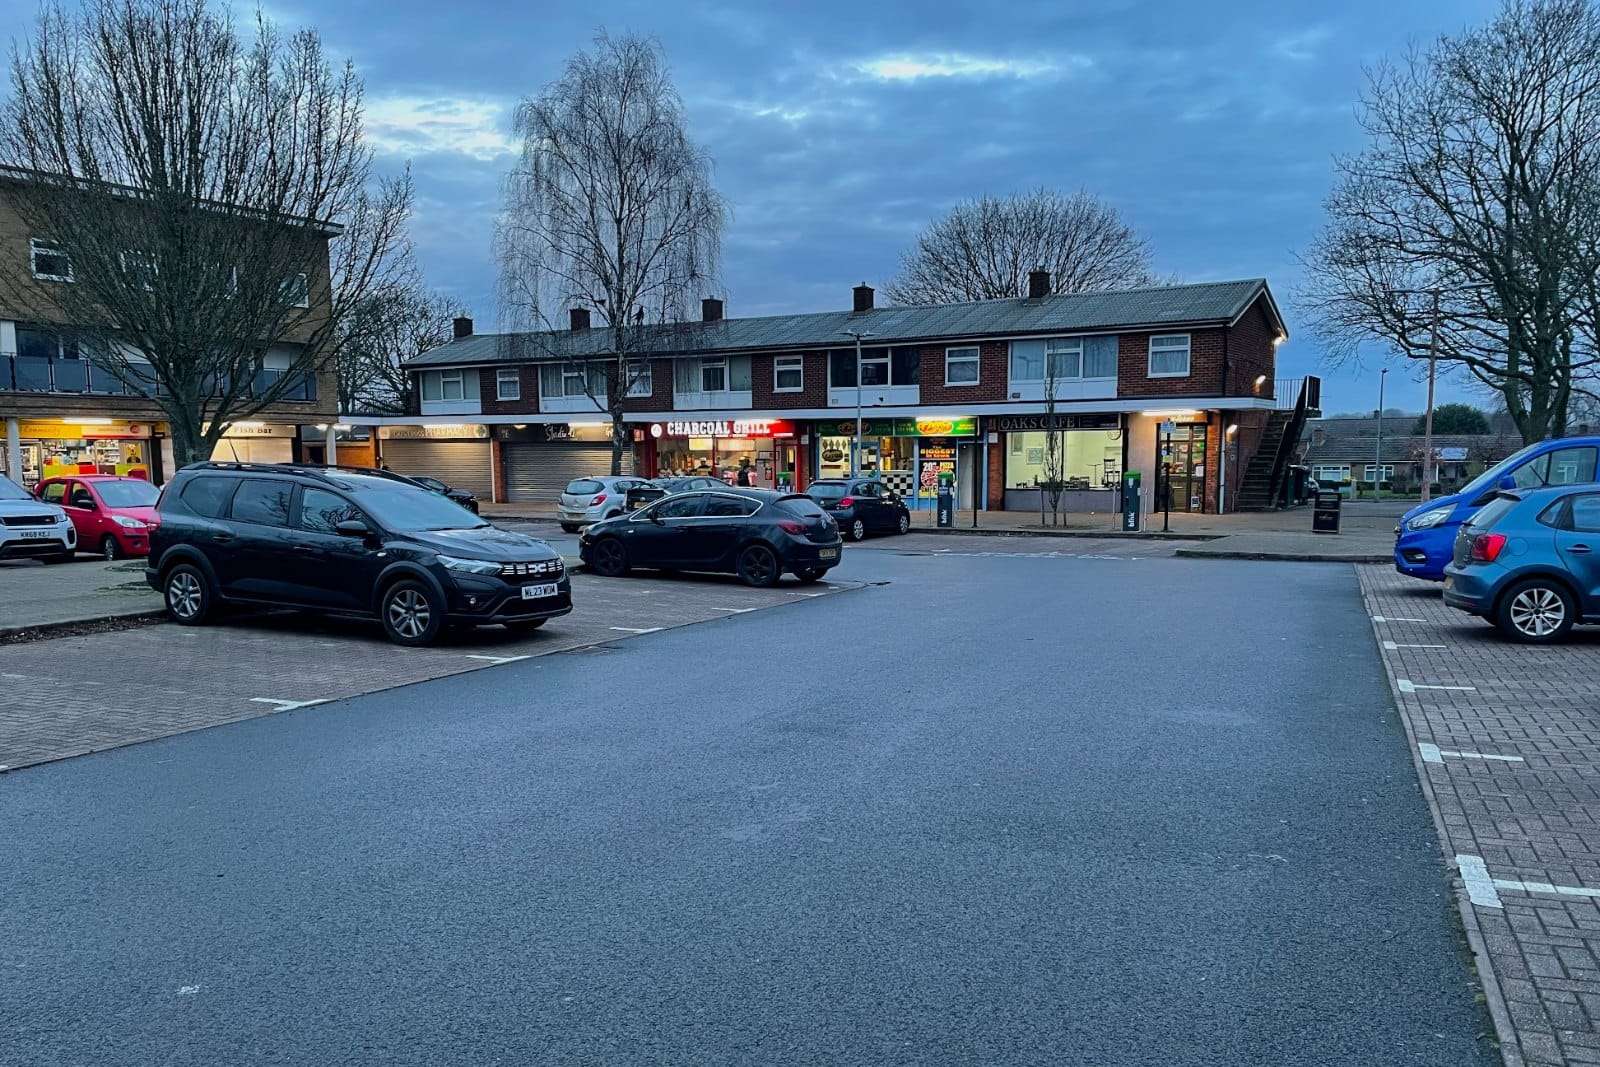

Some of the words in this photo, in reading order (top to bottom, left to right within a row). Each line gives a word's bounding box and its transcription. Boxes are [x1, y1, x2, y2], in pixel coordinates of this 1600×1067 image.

[667, 421, 730, 435] CHARCOAL
[733, 421, 771, 434] GRILL
[1000, 417, 1037, 429] OAKS
[1040, 416, 1075, 429] CFE
